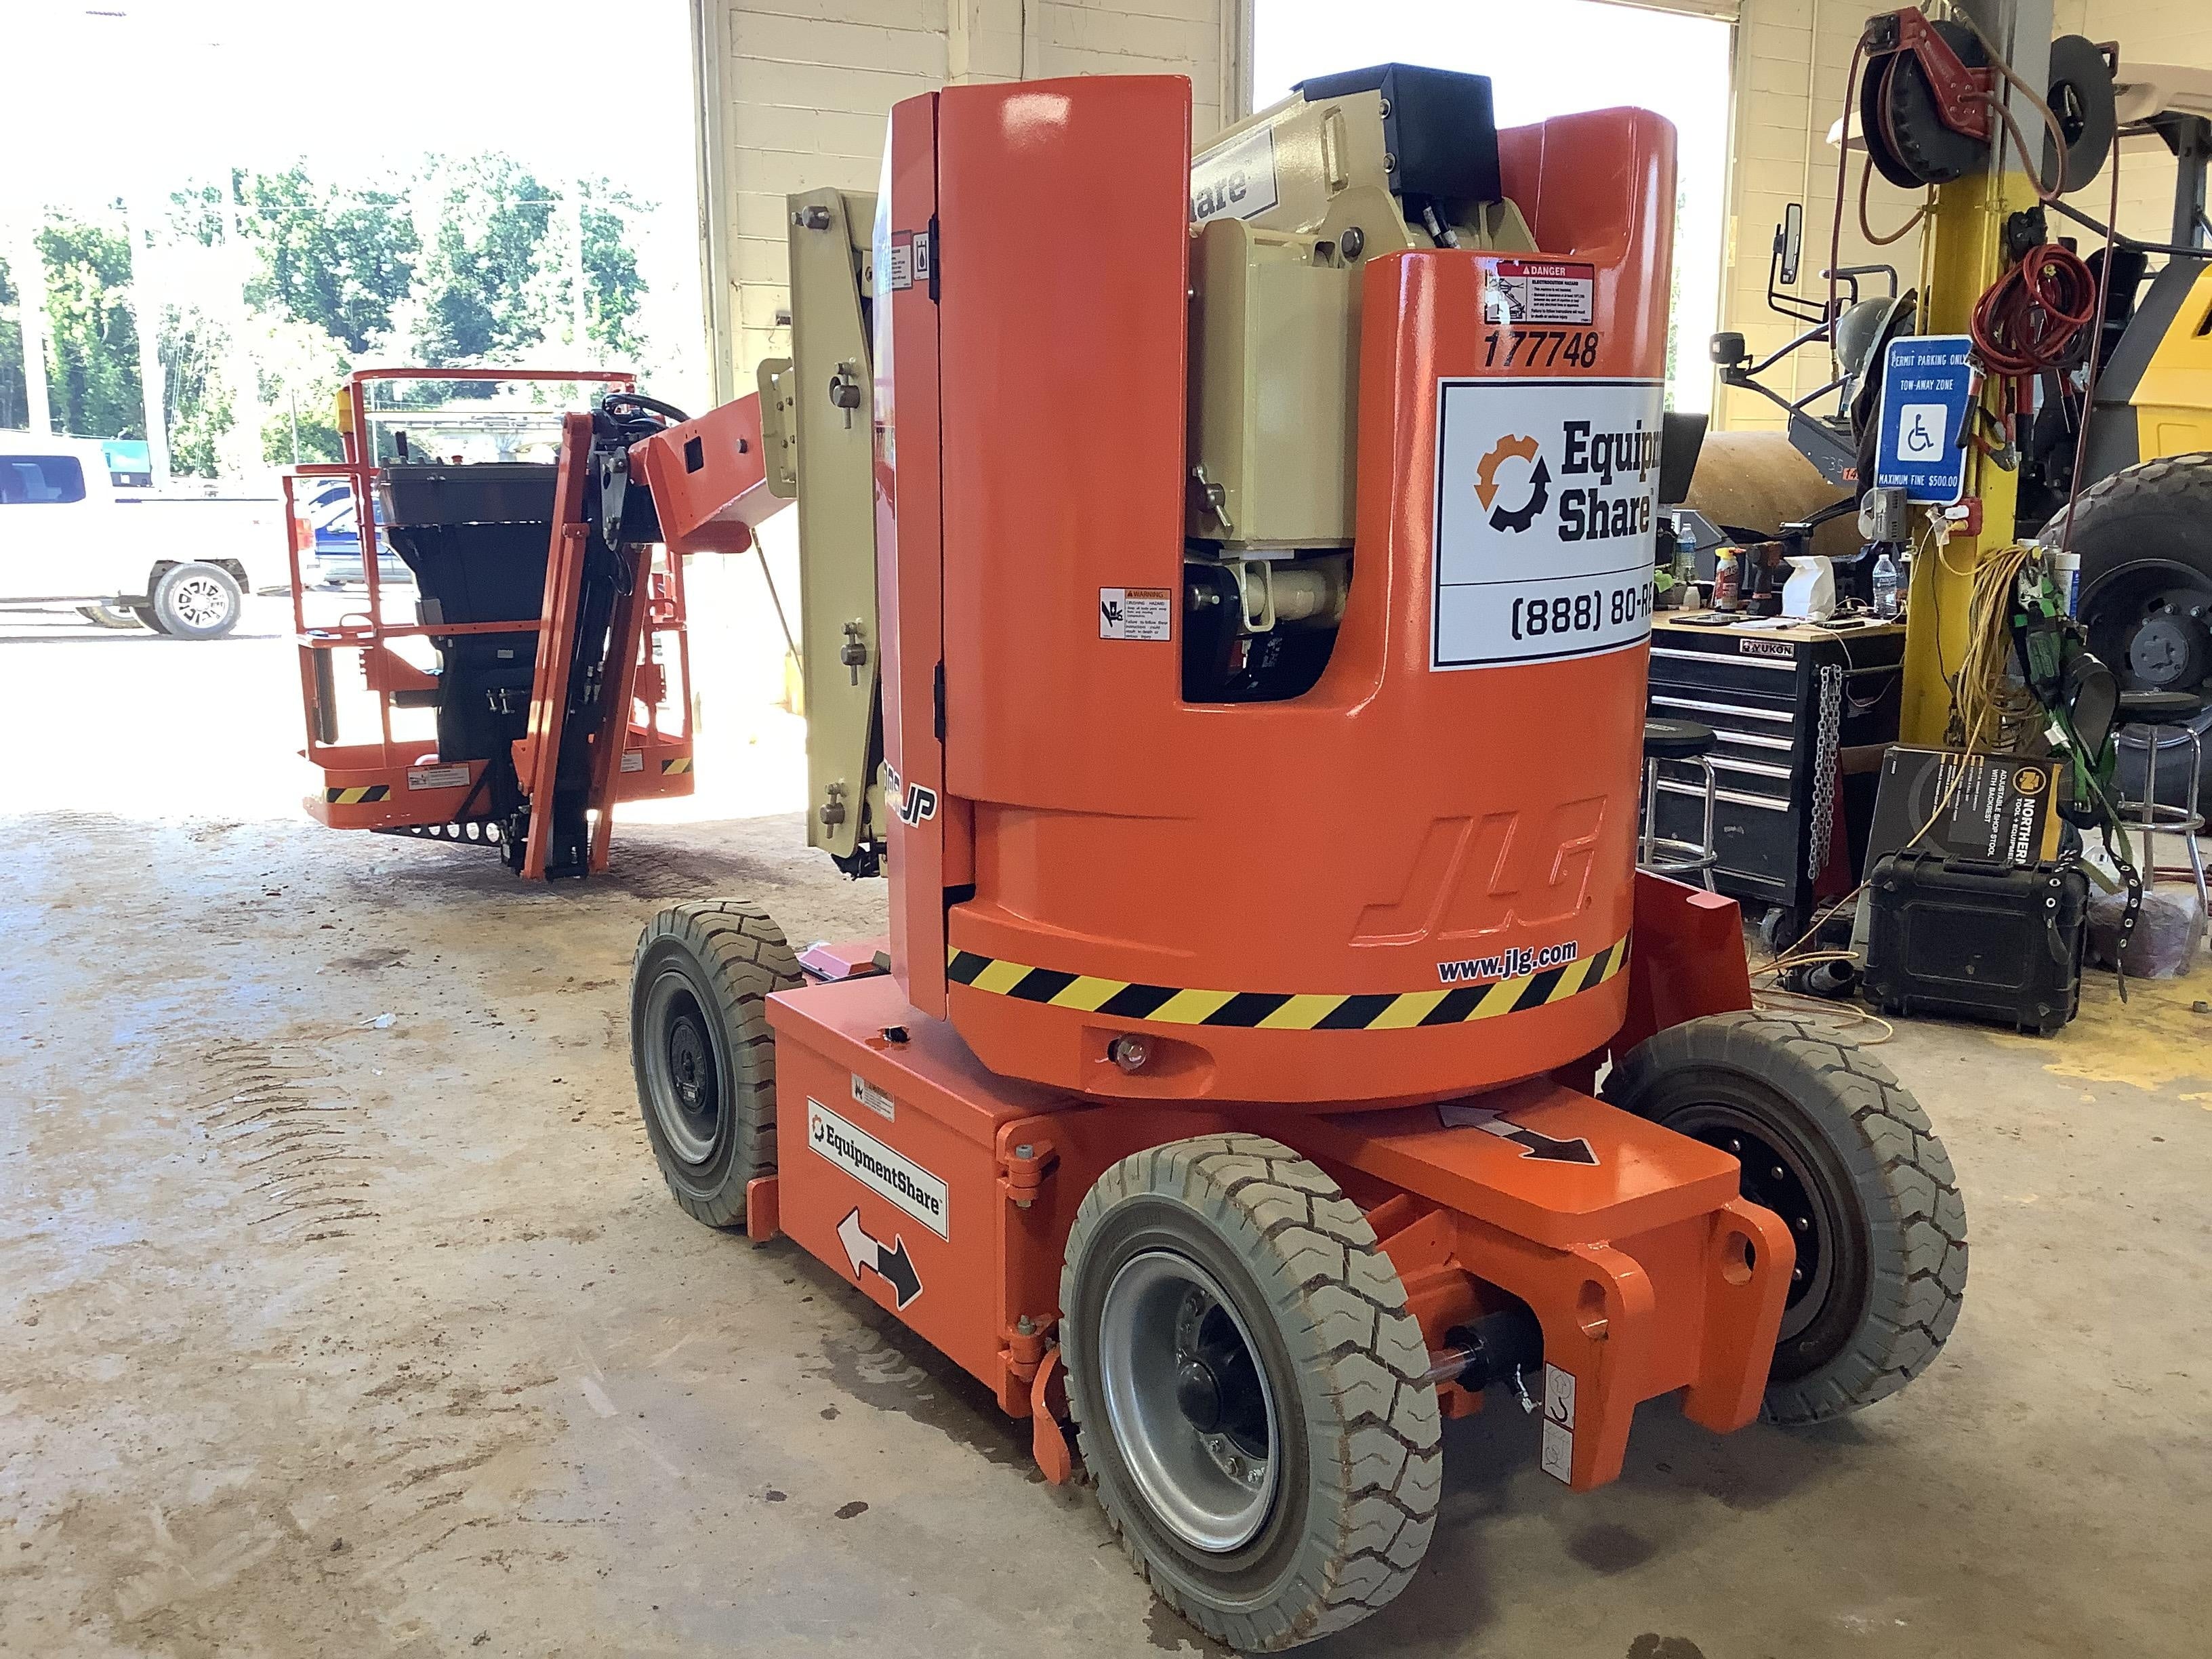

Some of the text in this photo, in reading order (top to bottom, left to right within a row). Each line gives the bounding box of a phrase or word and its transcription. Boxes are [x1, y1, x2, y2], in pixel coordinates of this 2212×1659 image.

[1532, 266, 1565, 276] DANGER
[1485, 331, 1599, 367] 177748
[1891, 354, 1967, 367] PERMIT PARKING ONLY
[1900, 380, 1954, 390] TOW-AWAY ZONE
[1879, 474, 1957, 487] MAXIMUM FINE $500.00
[1559, 488, 1650, 541] Share
[1511, 590, 1601, 640] (888)
[1754, 643, 1791, 655] YUKON
[1984, 769, 1999, 823] WITH BACKREST
[1987, 769, 2007, 857] ADJUSTABLE SHOP STOOL
[2014, 798, 2023, 817] TOOL
[1440, 941, 1577, 983] www.jlg.com
[826, 1123, 939, 1216] EquipmentShare
